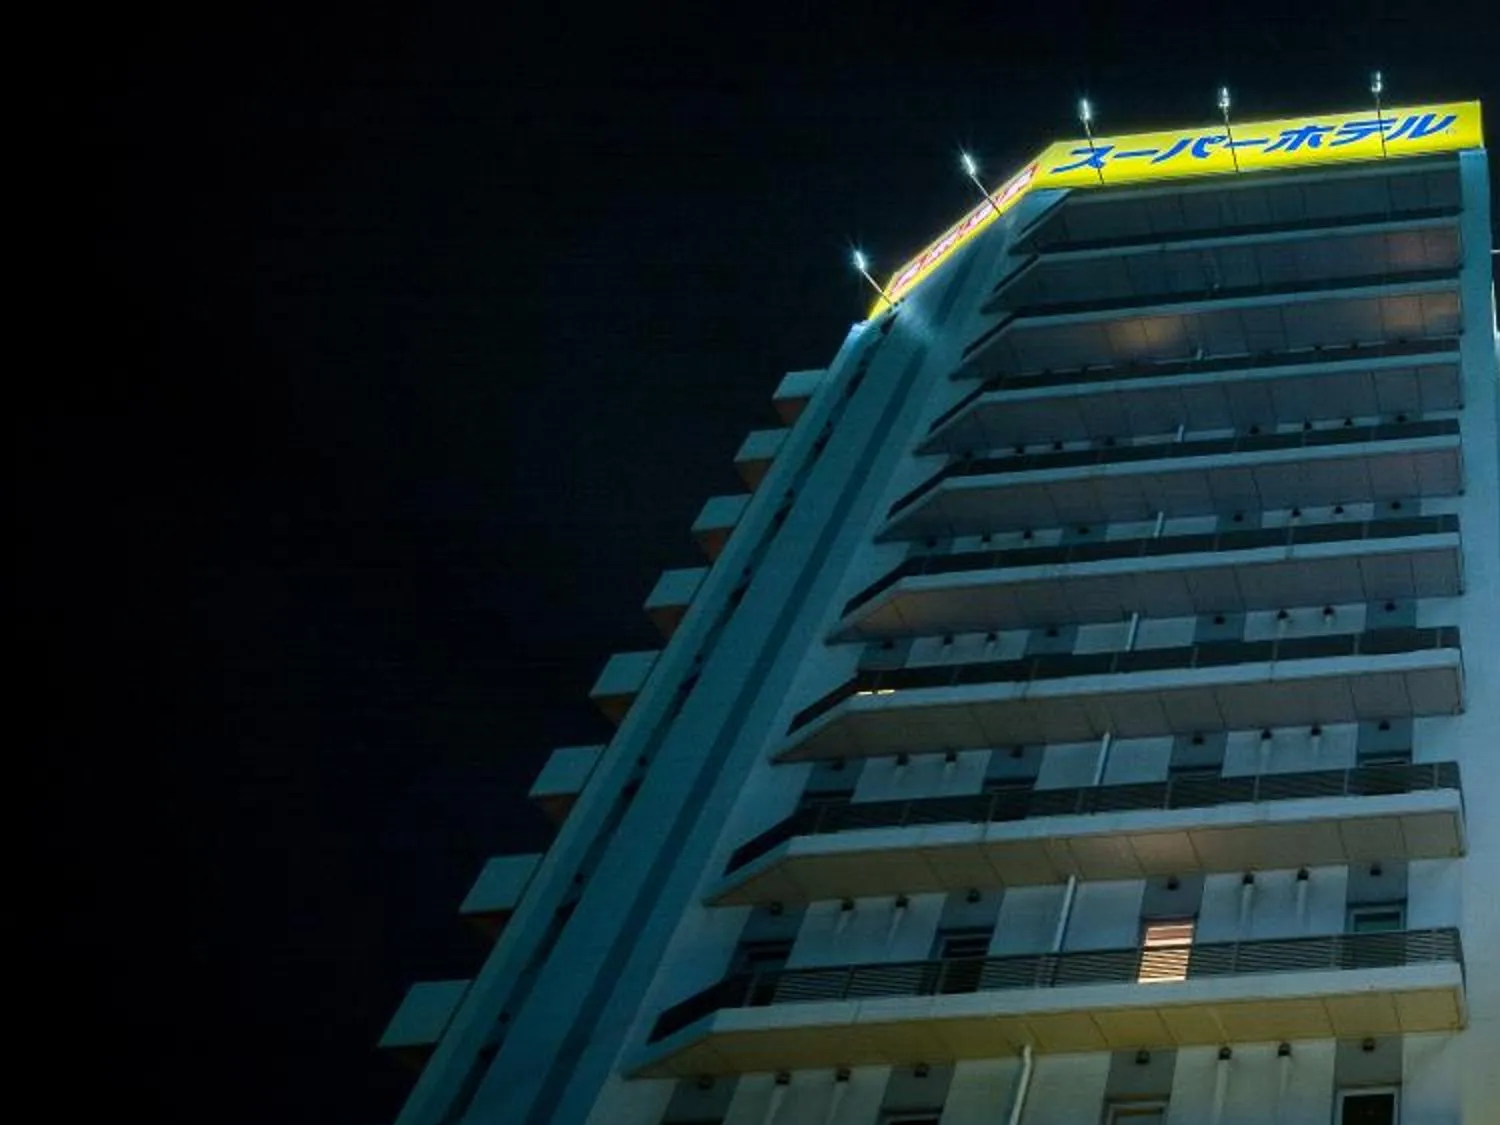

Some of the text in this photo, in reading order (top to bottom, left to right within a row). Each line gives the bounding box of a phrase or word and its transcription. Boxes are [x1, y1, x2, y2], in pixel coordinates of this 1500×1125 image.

[1053, 113, 1458, 174] スーパーホテル
